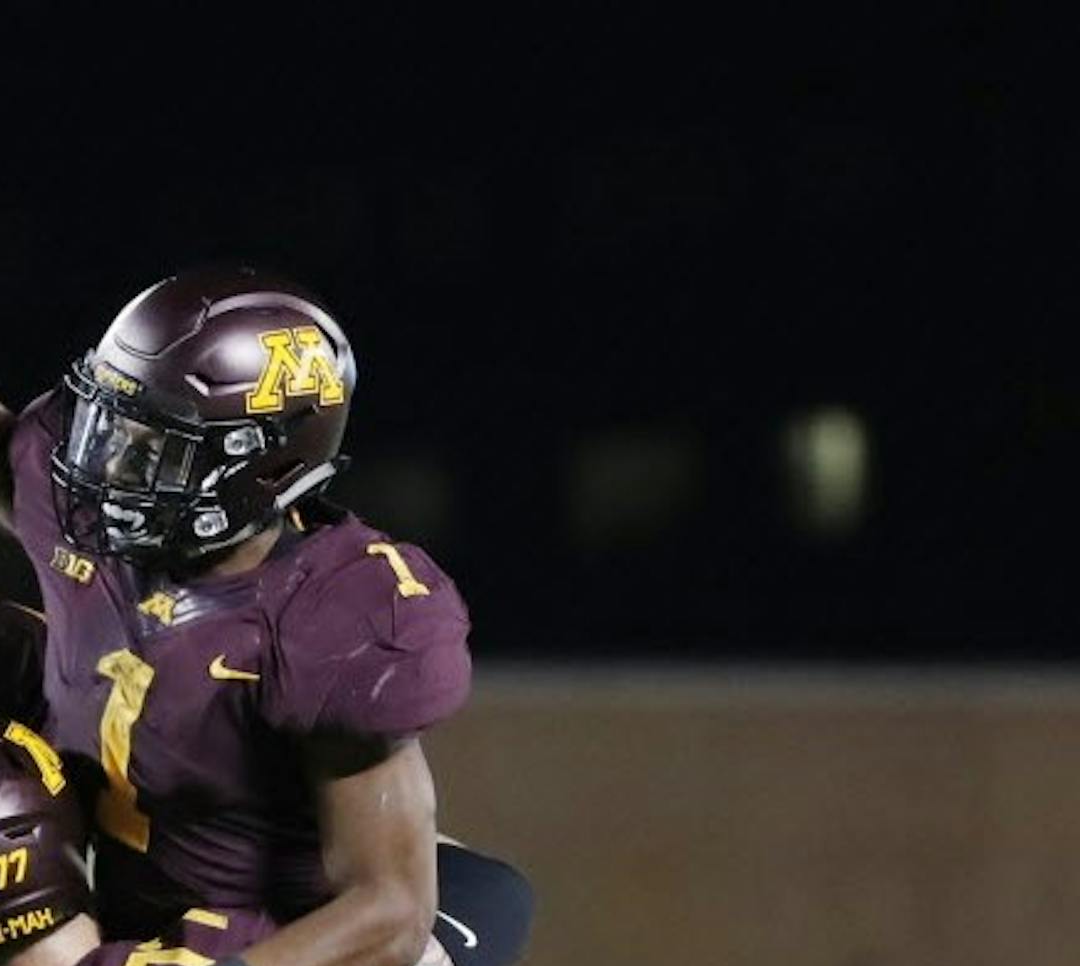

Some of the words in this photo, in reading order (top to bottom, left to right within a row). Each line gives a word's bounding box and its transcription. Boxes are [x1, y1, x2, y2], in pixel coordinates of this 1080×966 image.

[246, 326, 345, 414] M
[366, 542, 431, 599] 1
[97, 648, 156, 854] 1
